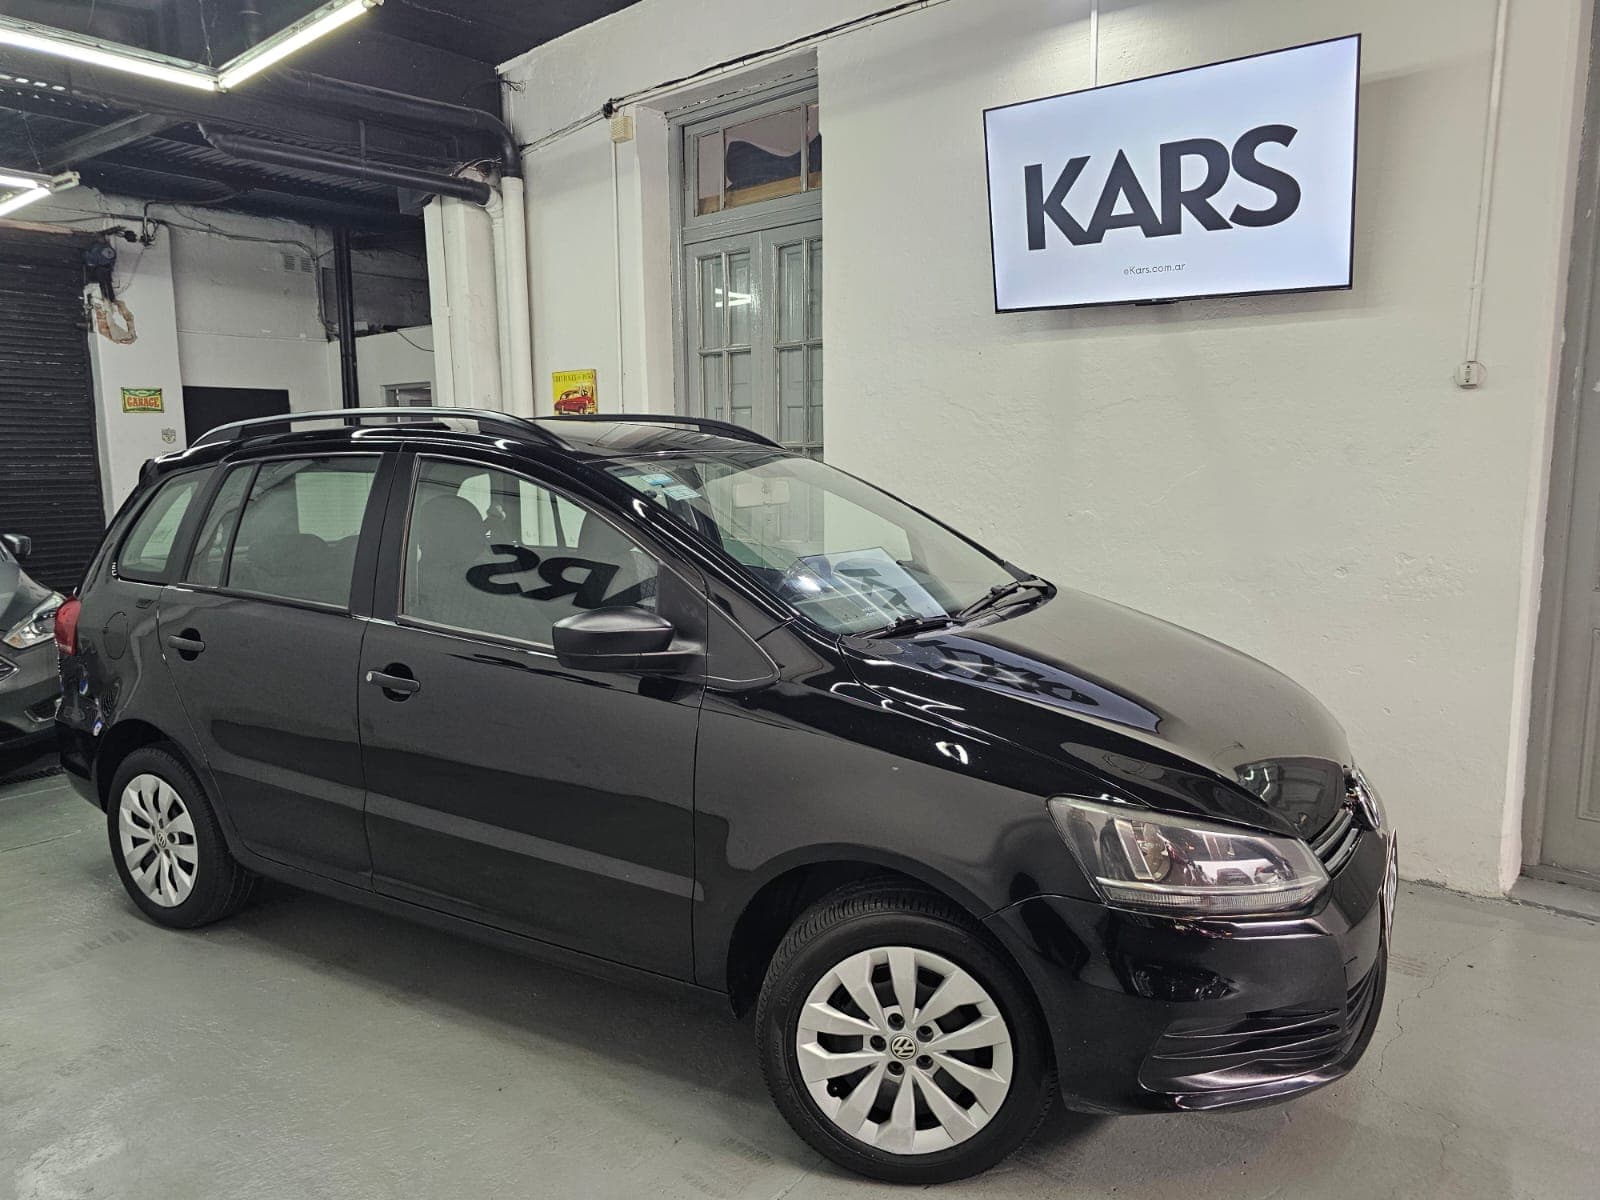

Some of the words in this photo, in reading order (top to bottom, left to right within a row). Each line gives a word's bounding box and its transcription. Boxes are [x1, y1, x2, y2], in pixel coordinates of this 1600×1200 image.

[1024, 124, 1301, 250] KARS
[1123, 263, 1186, 275] eKars.com.ar
[127, 396, 159, 407] GARAGE
